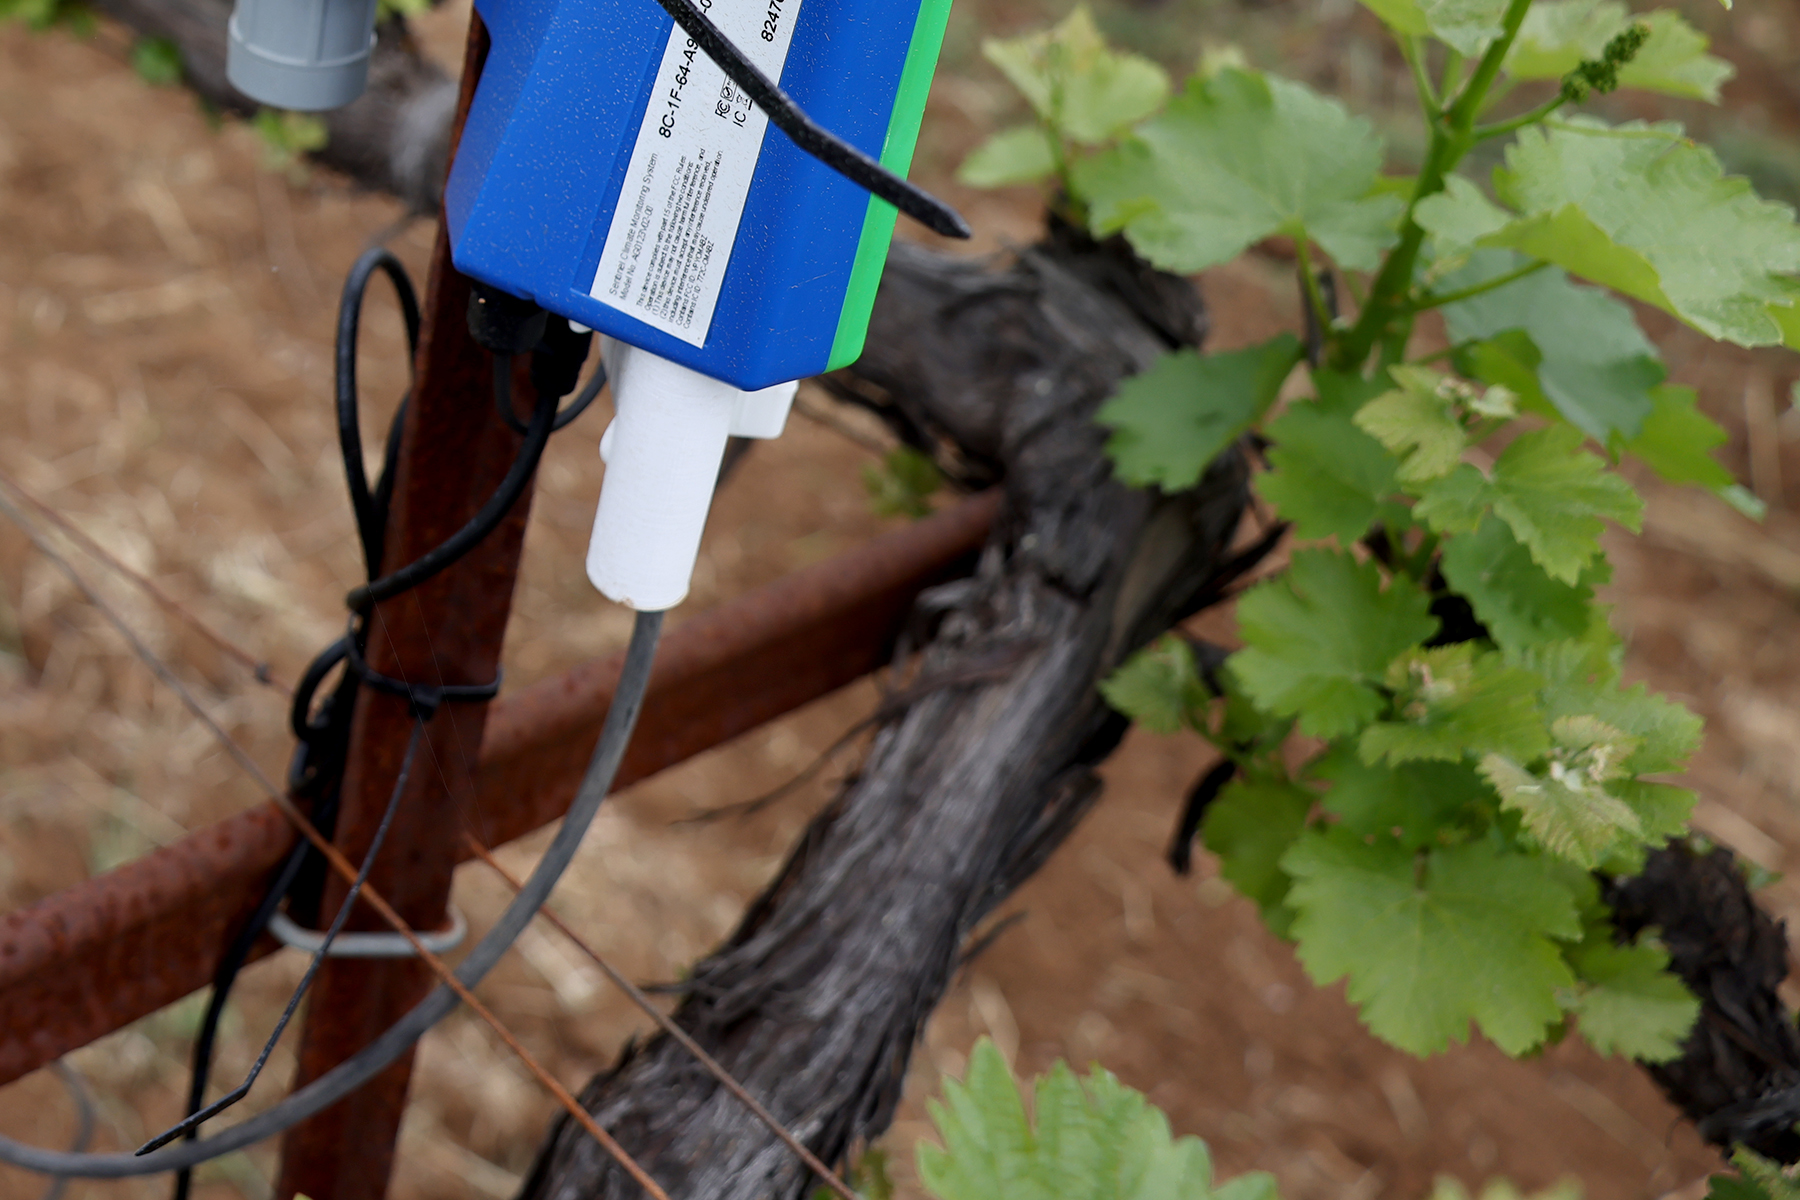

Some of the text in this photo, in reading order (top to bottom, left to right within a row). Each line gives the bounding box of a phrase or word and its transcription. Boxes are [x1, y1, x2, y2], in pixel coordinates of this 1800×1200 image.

[732, 110, 746, 127] IC
[687, 189, 702, 227] interference
[608, 152, 658, 295] Sentinel Climate Monitoring System
[644, 280, 658, 310] Operation
[667, 205, 681, 233] following
[647, 243, 660, 271] complies
[668, 294, 682, 322] including
[676, 257, 691, 294] interference
[701, 180, 713, 212] undesired
[618, 275, 632, 300] Model
[675, 297, 689, 325] Contains
[682, 301, 696, 328] Contains
